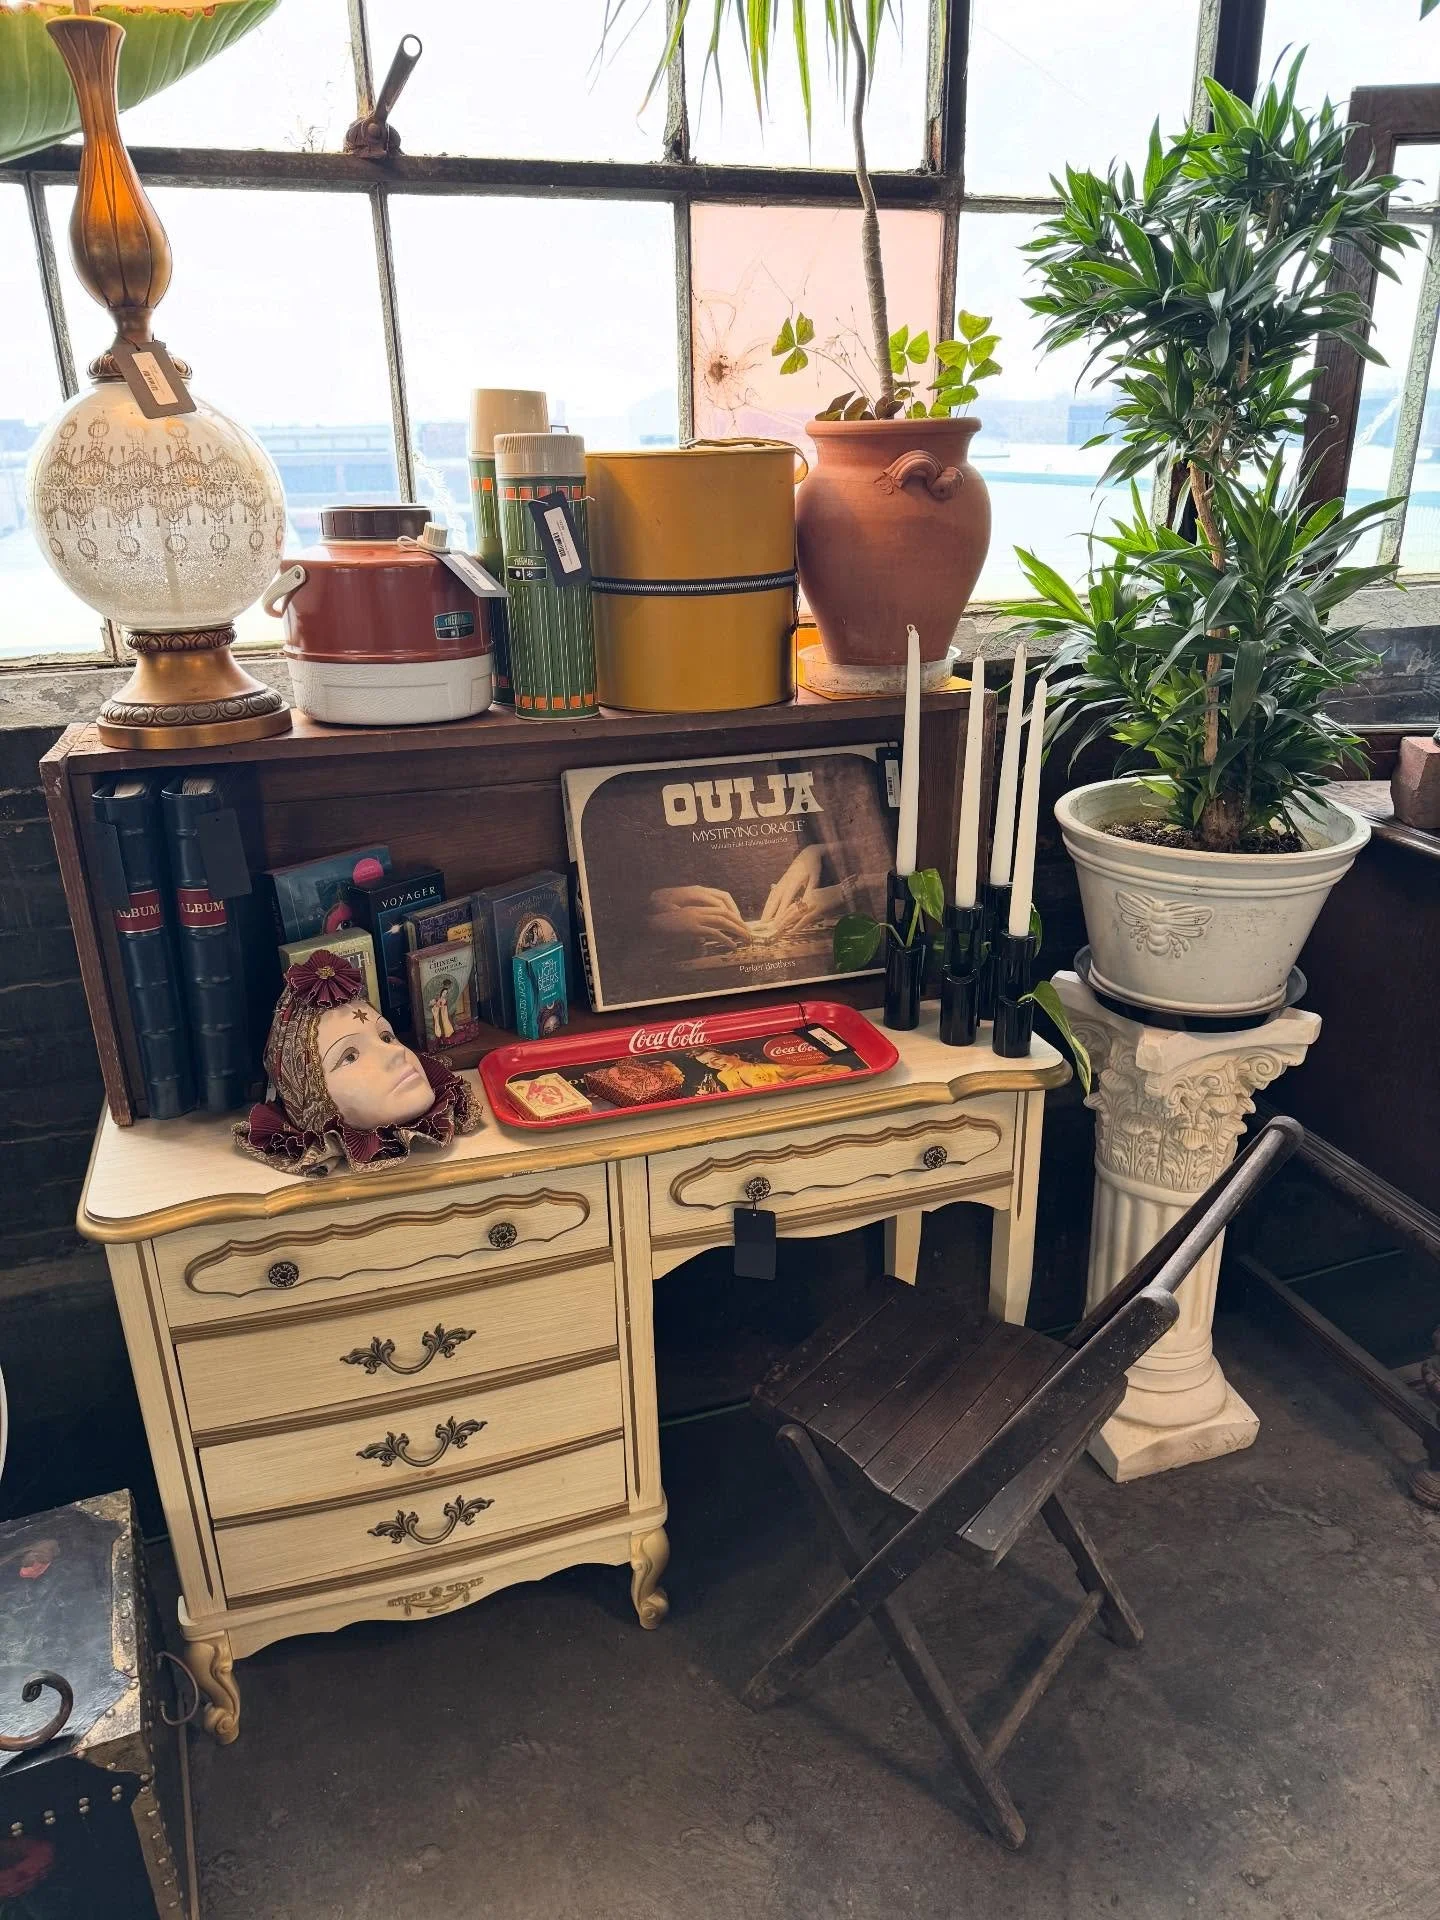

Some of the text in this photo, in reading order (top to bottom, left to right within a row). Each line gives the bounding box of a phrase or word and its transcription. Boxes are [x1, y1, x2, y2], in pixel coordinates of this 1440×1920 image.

[661, 771, 825, 827] OUIJA
[692, 820, 803, 843] MYSTIFYING ORACLE
[381, 886, 436, 909] VOYAGER
[739, 959, 796, 973] Parker Brothers
[628, 1019, 707, 1053] Coca-Cola
[770, 1042, 818, 1057] Coca-Co
